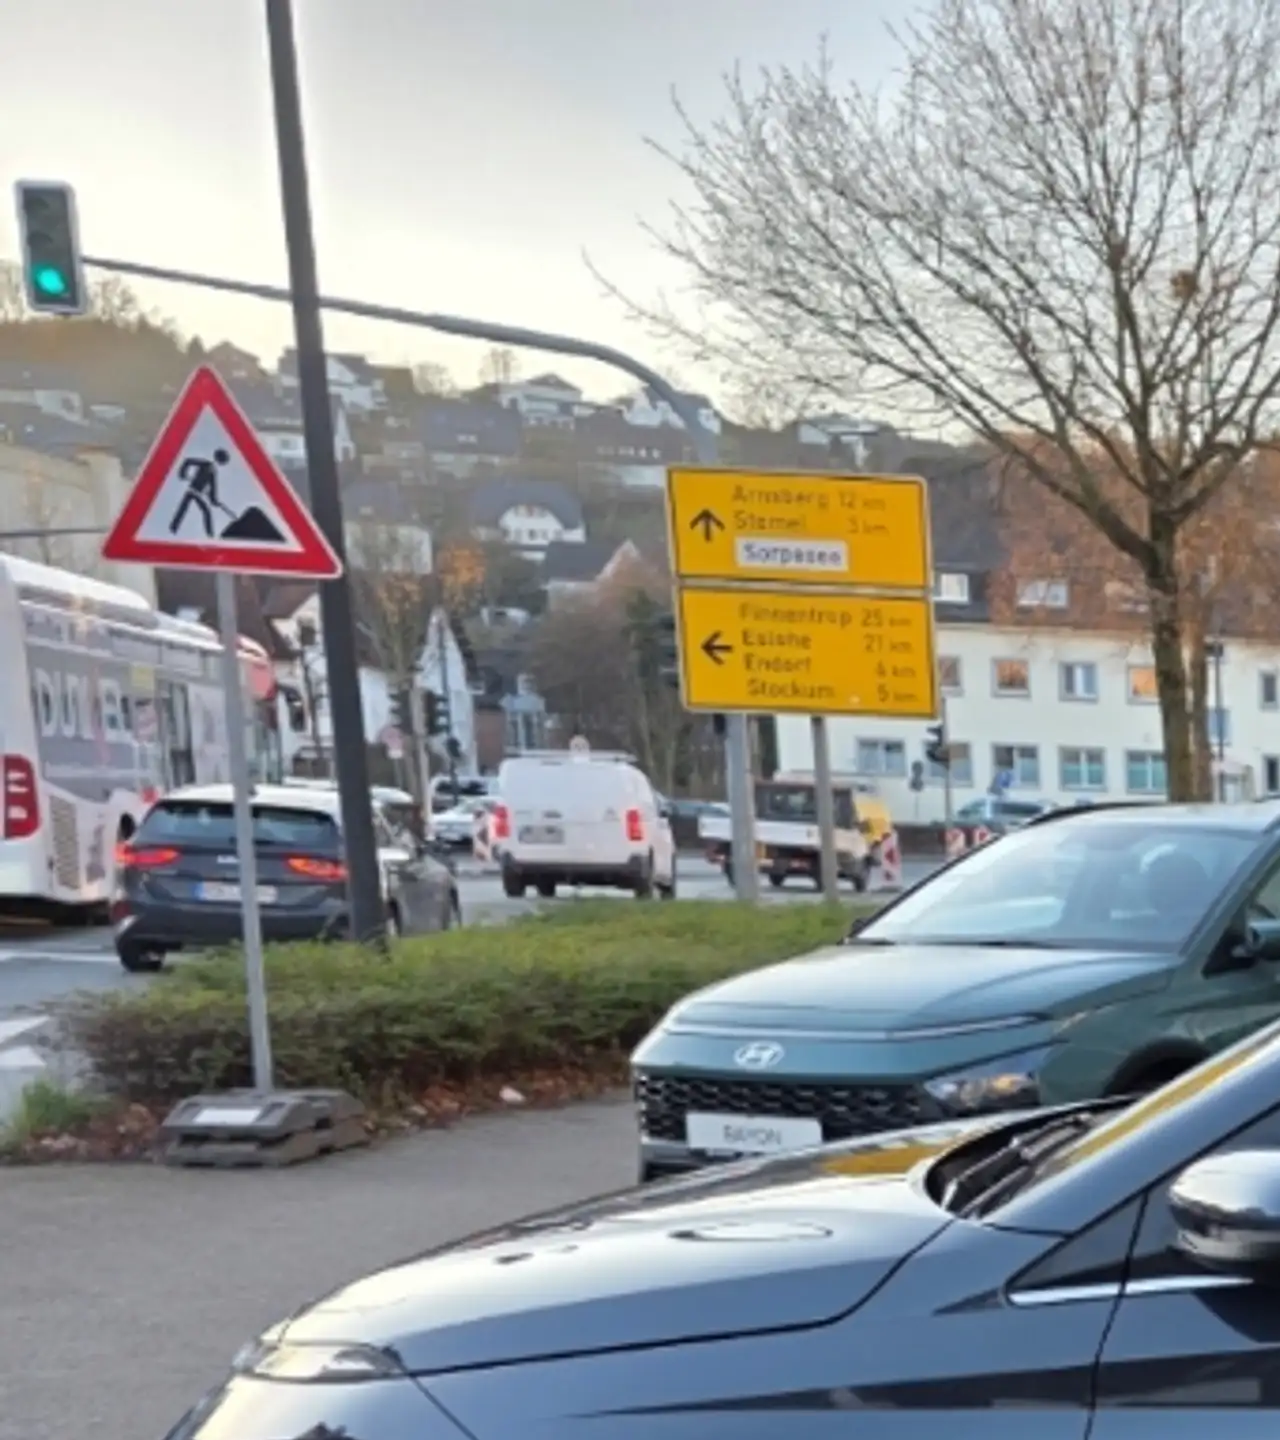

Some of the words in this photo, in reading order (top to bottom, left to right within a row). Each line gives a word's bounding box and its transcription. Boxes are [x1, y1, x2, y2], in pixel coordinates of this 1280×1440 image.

[863, 518, 889, 534] km
[861, 608, 883, 628] 25
[891, 664, 917, 679] km
[746, 677, 835, 699] Stockum
